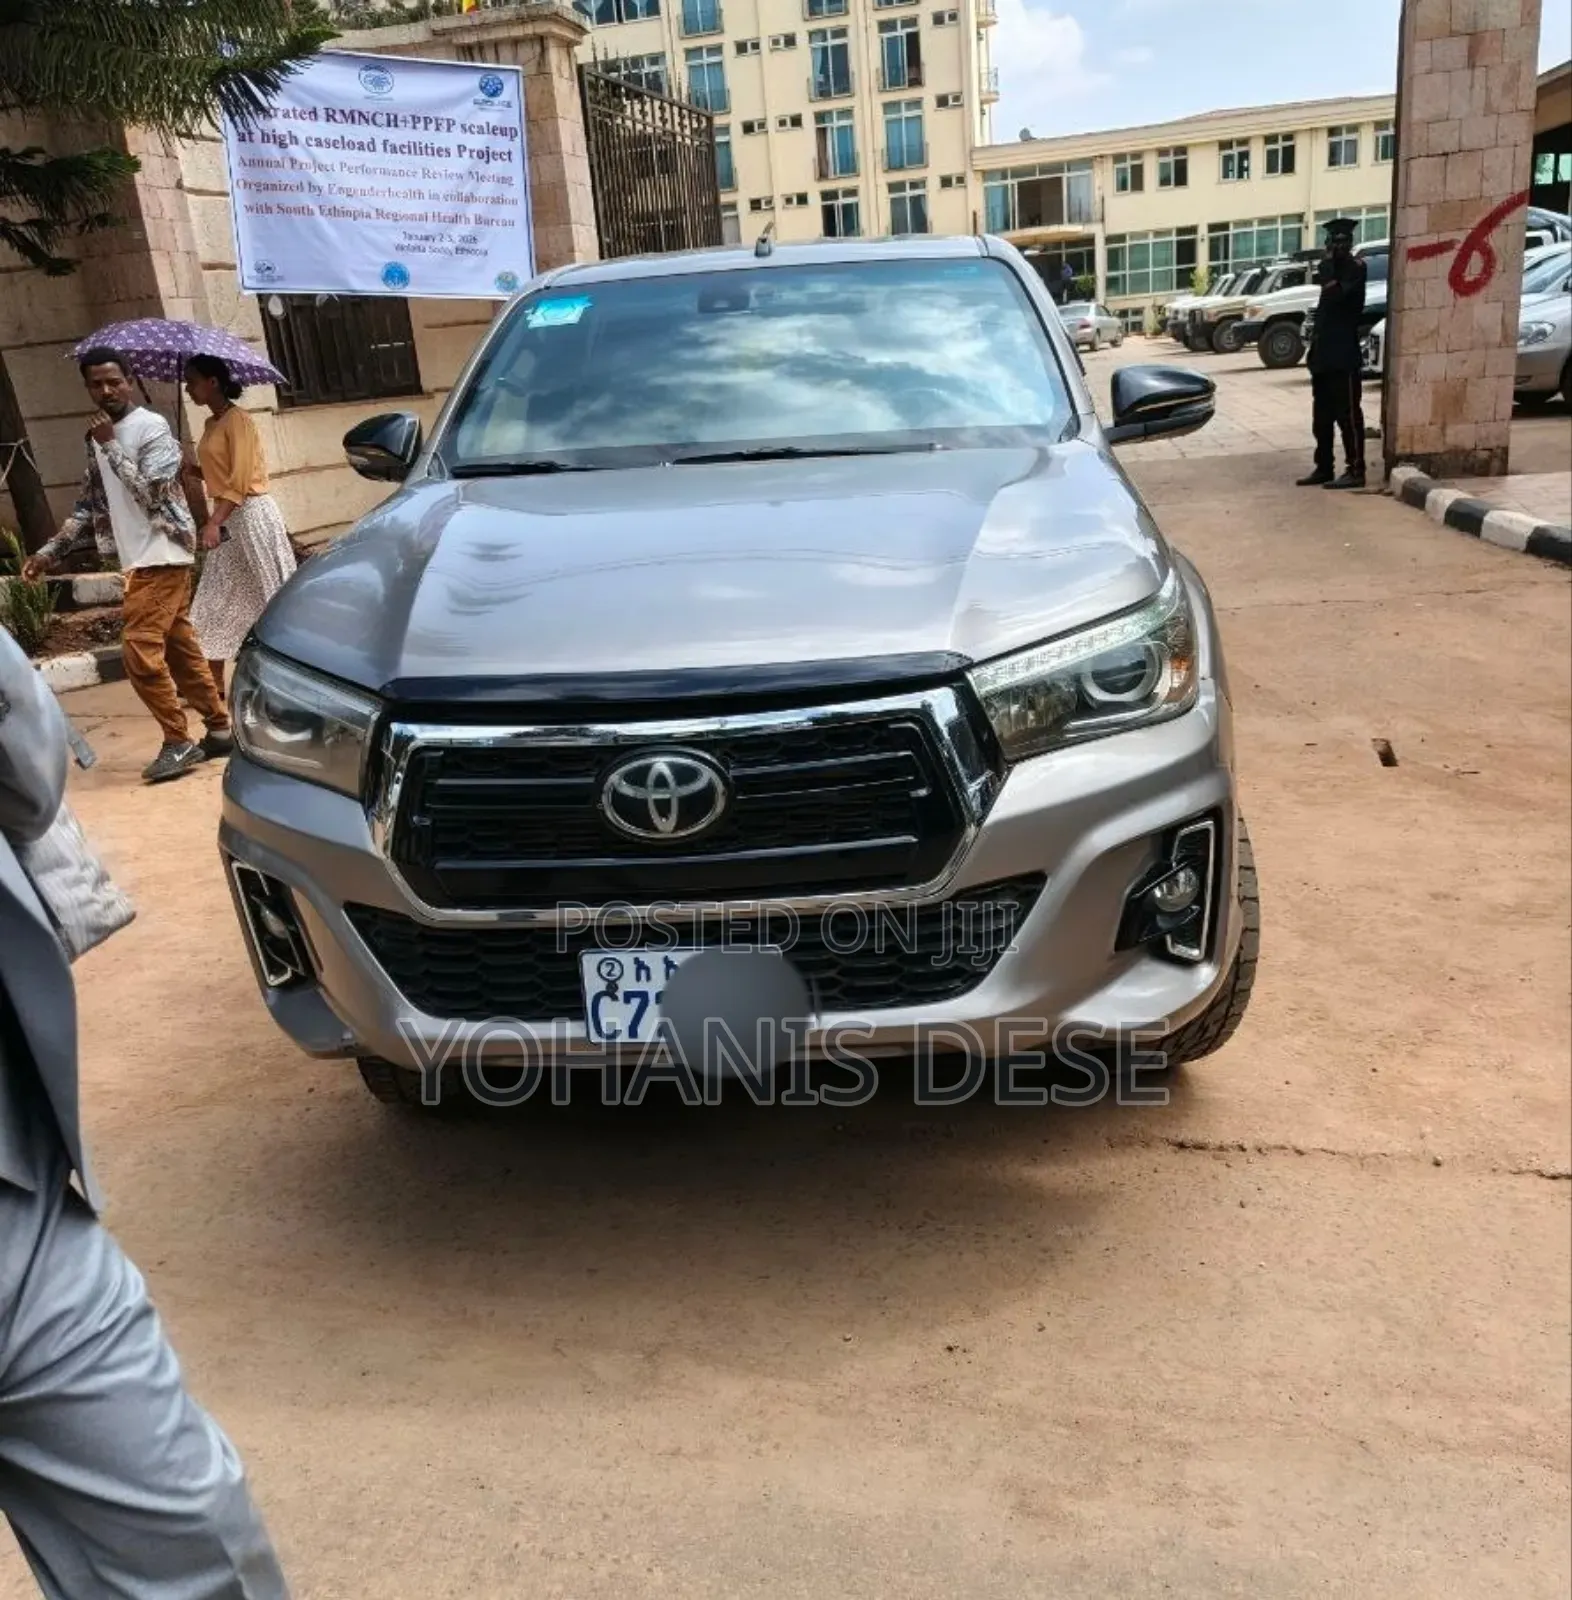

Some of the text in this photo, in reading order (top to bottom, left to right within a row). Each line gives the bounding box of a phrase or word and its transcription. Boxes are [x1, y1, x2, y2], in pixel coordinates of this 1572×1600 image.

[323, 106, 457, 133] RMNCH+PPFP
[460, 121, 518, 142] scaleup
[237, 128, 513, 164] at high caseload facilities Project
[237, 155, 515, 186] Annual Project Performance Review Meeting
[236, 178, 304, 193] Organized
[308, 181, 323, 197] by
[428, 188, 440, 201] in
[442, 190, 518, 206] collaboration
[243, 202, 515, 227] with South Ethiopia Regional Health Bureau
